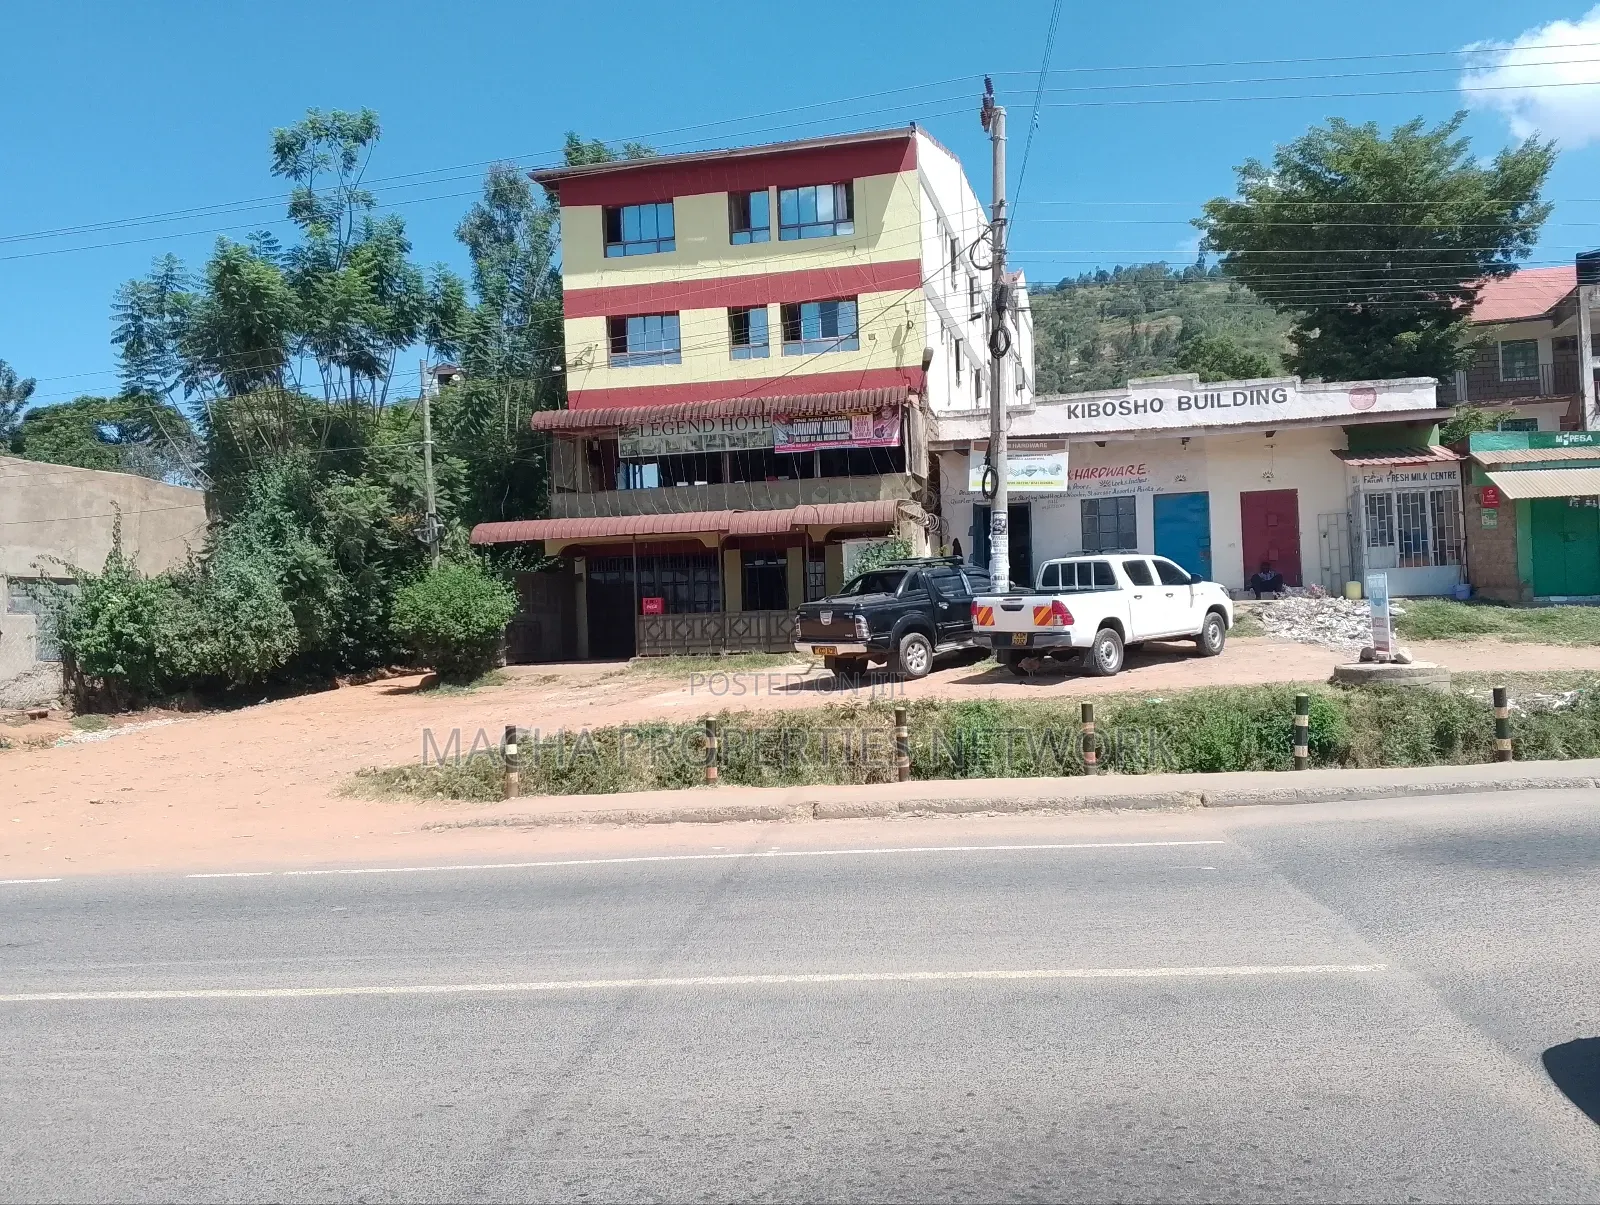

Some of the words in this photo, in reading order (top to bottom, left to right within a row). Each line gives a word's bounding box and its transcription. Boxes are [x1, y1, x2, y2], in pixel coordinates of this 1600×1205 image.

[1067, 397, 1164, 420] KIBOSHO
[1177, 387, 1288, 412] BUILDING
[638, 418, 715, 438] LEGEND
[721, 414, 773, 432] HOTE
[1387, 472, 1410, 483] FRESH
[1411, 472, 1428, 482] MILK
[1431, 470, 1457, 480] CENTRE
